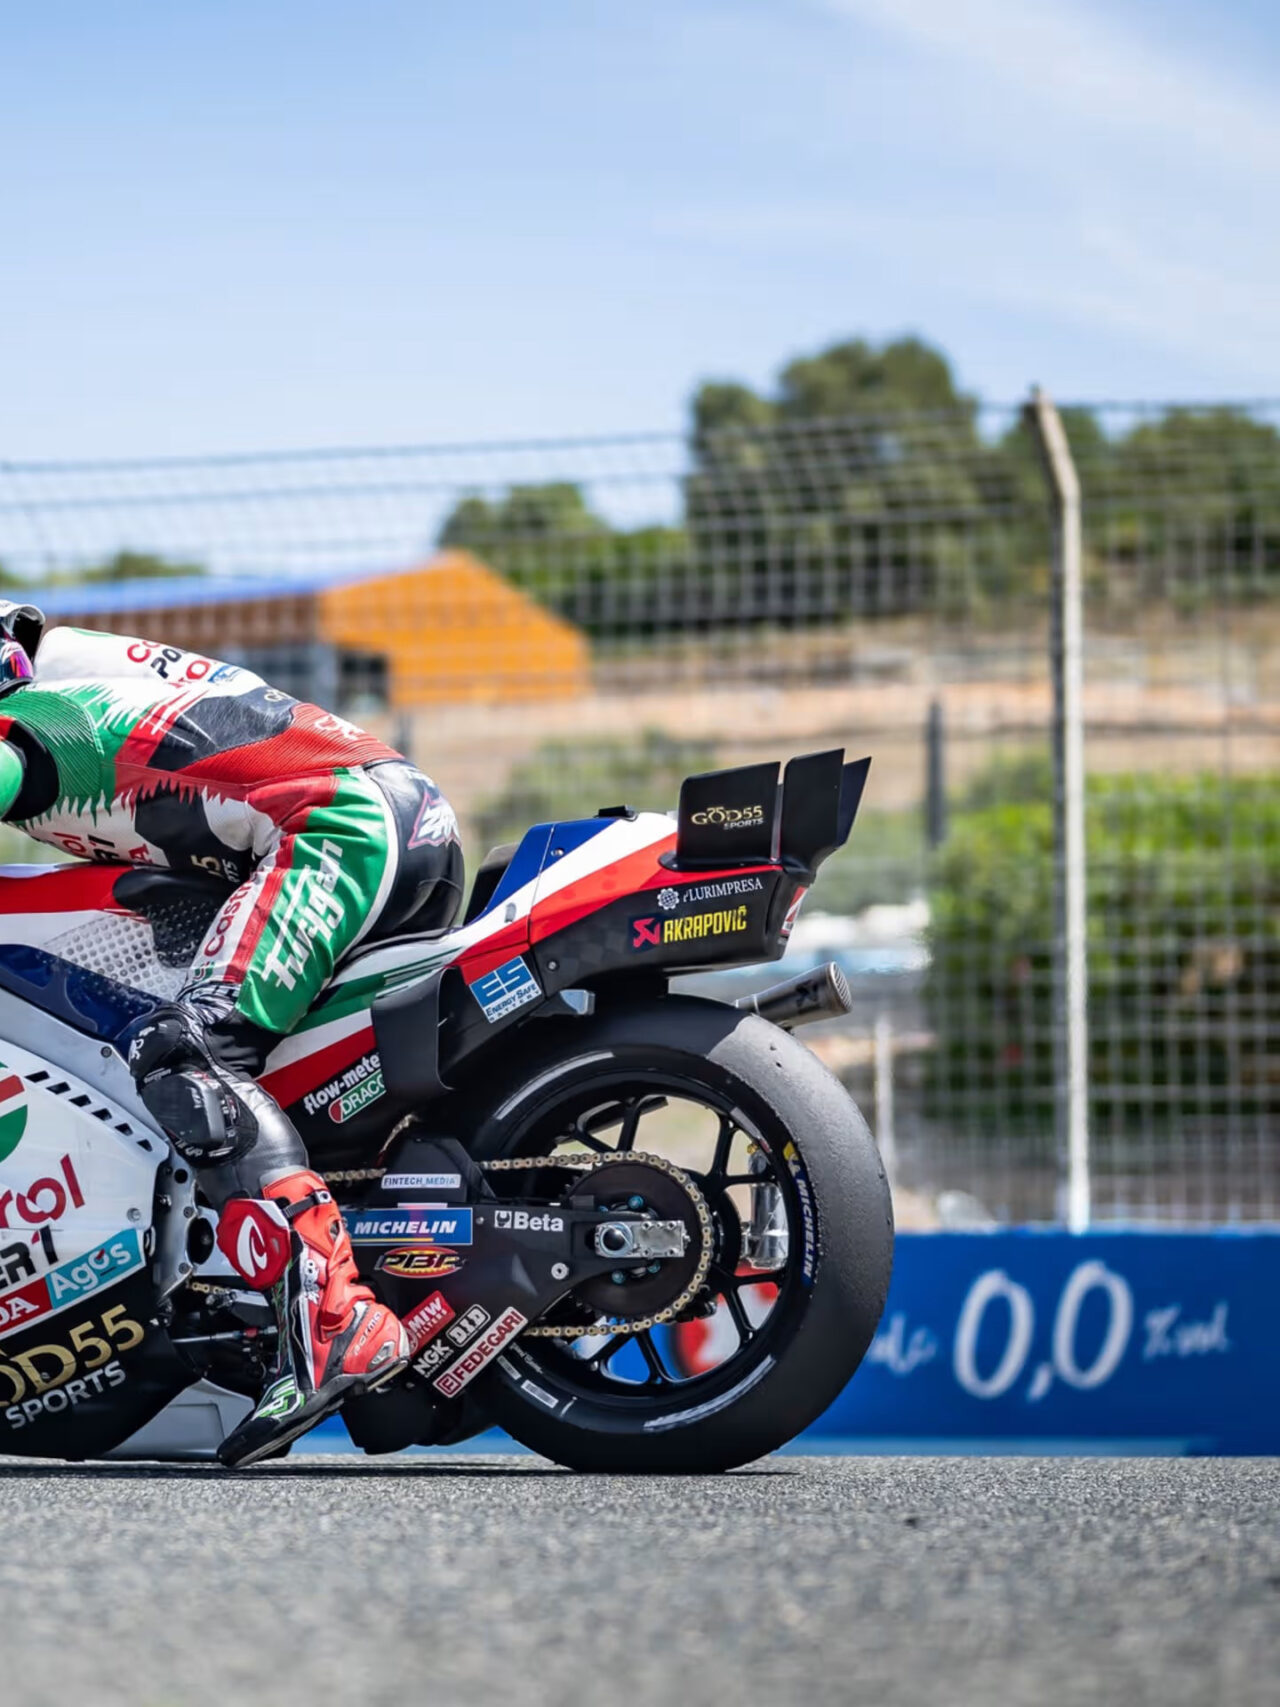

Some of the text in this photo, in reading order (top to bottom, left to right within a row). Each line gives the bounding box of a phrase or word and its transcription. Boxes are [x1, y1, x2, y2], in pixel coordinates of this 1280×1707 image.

[723, 818, 764, 830] SPORTS
[204, 873, 260, 957] Castr
[303, 1054, 381, 1115] flow-mete
[354, 1221, 457, 1234] MICHELIN
[513, 1212, 564, 1232] Beta
[796, 1178, 815, 1278] MICHELIN
[408, 1297, 444, 1333] MIW
[453, 1310, 524, 1381] FEDEGARI
[952, 1259, 1134, 1401] 0,0
[412, 1338, 452, 1376] NGK
[5, 1360, 127, 1430] SPORTS
